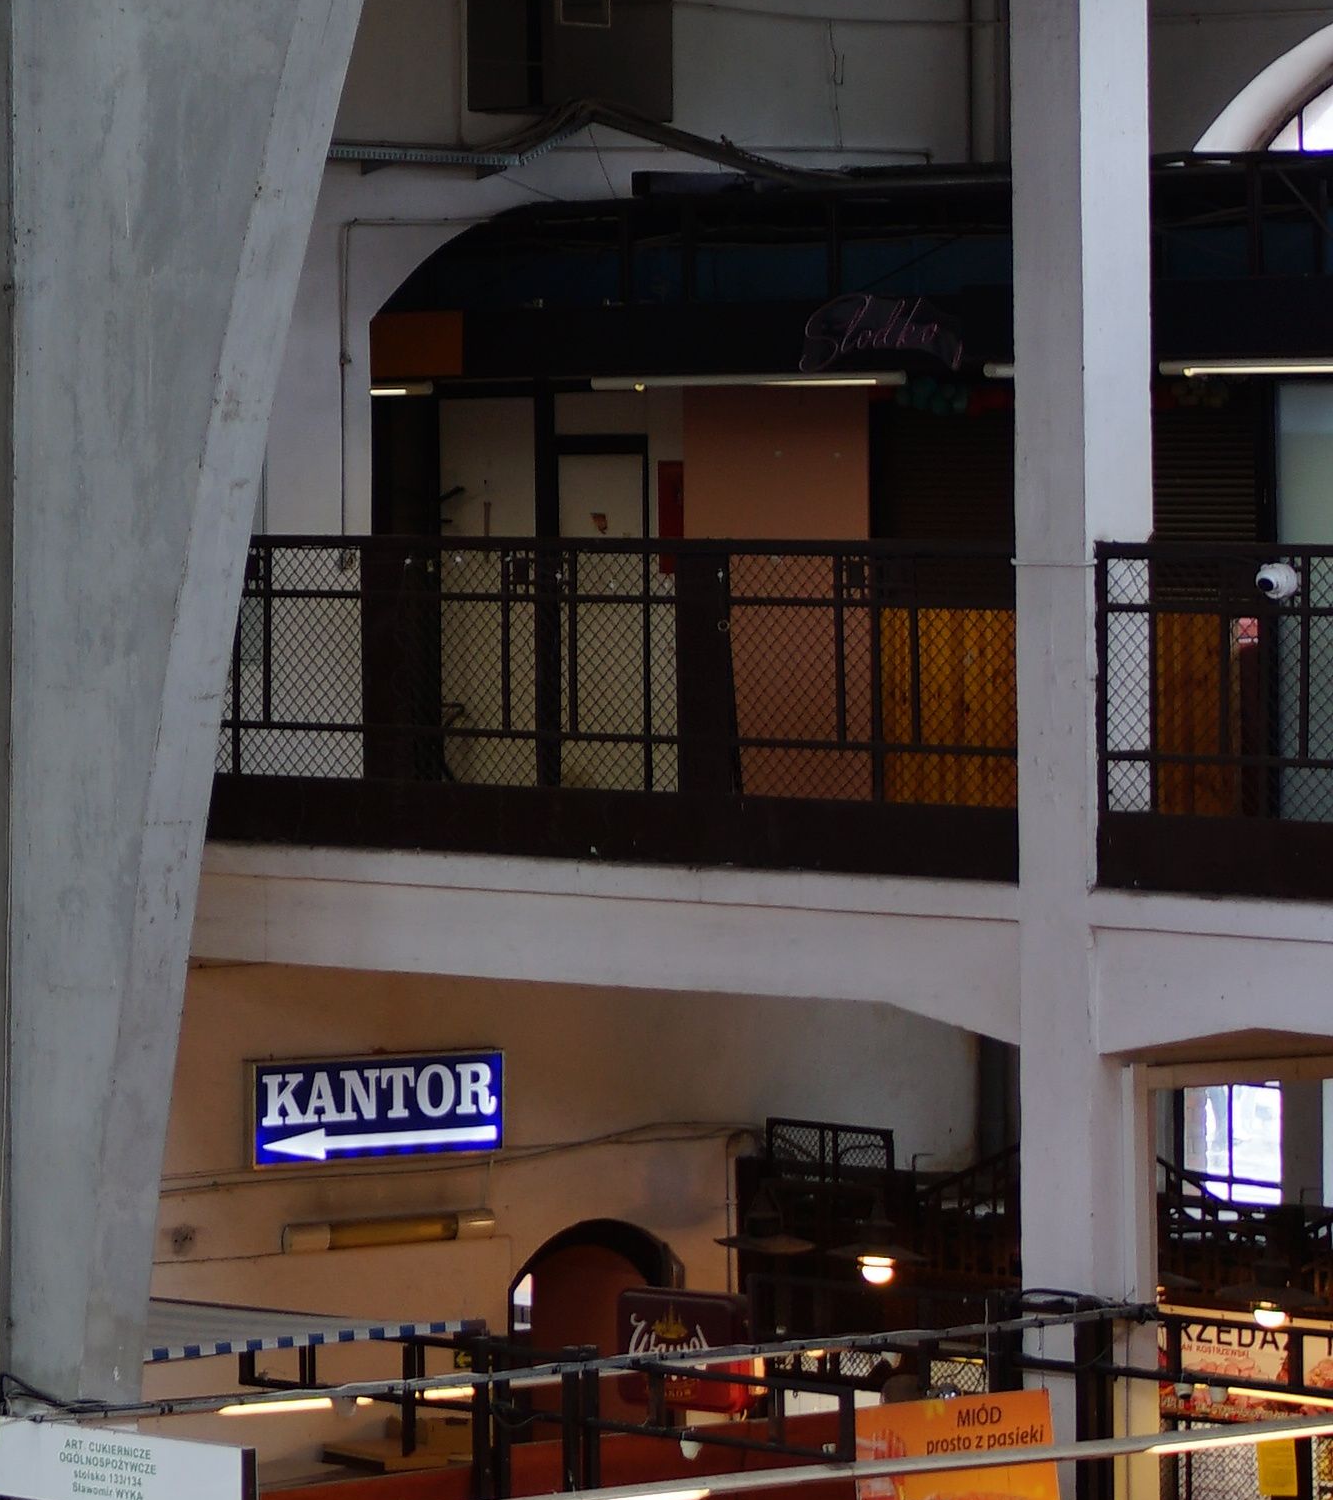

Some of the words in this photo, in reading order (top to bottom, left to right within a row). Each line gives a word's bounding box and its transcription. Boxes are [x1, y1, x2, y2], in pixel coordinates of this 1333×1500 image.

[261, 1062, 498, 1128] KANTOR
[956, 1403, 1002, 1428] MIÓD
[88, 1440, 151, 1460] CUKIERNICZE
[926, 1433, 971, 1455] prosto
[975, 1435, 983, 1449] z
[987, 1424, 1044, 1450] pasieki
